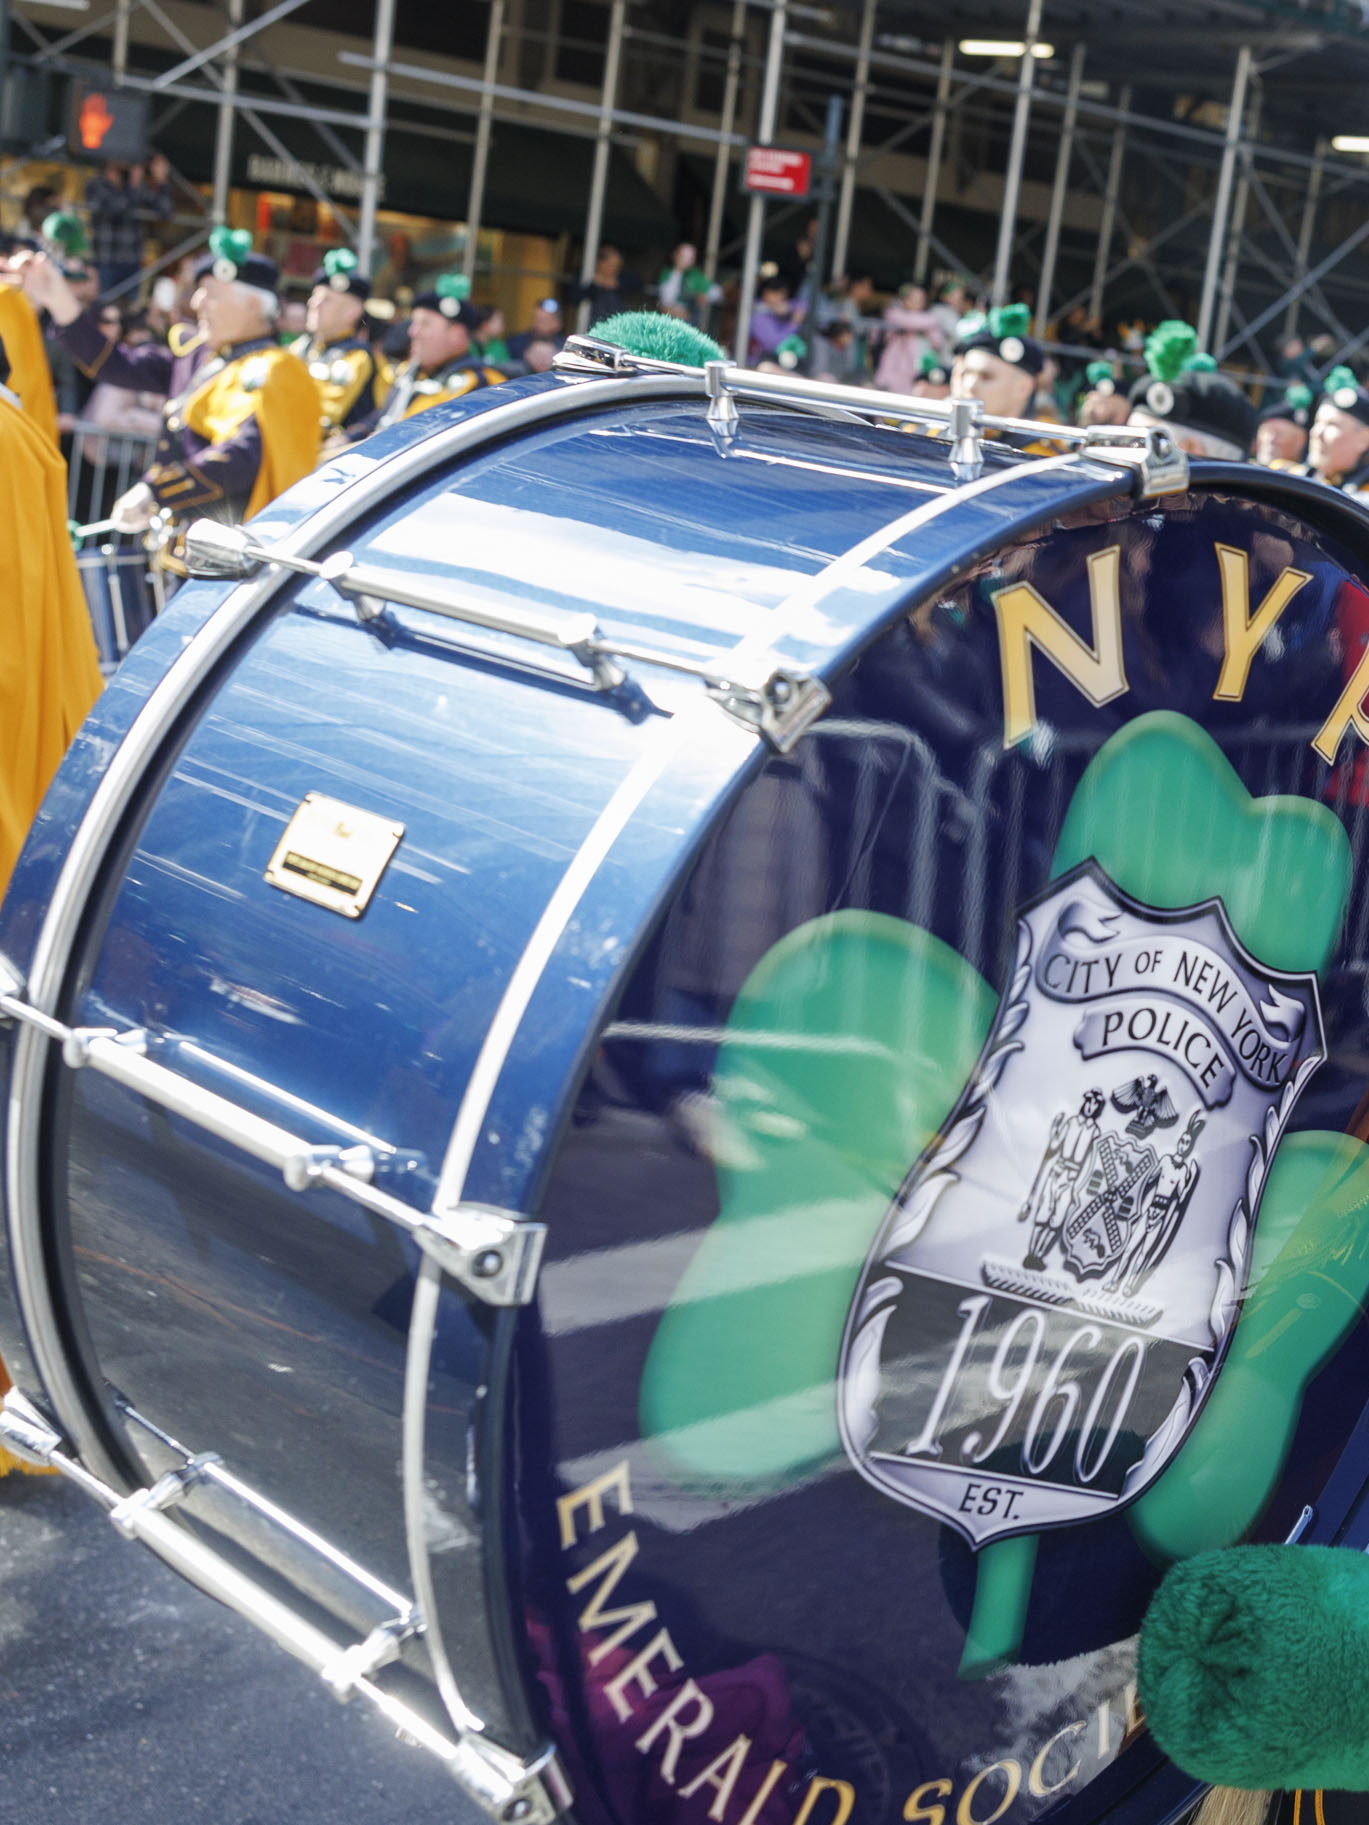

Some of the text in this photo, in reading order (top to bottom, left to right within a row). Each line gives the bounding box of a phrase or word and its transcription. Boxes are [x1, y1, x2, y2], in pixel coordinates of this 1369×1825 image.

[1043, 950, 1289, 1085] CITY OF NEW YORK
[1102, 1007, 1225, 1089] POLICE
[904, 1294, 1146, 1483] 1960
[958, 1482, 1025, 1520] EST.
